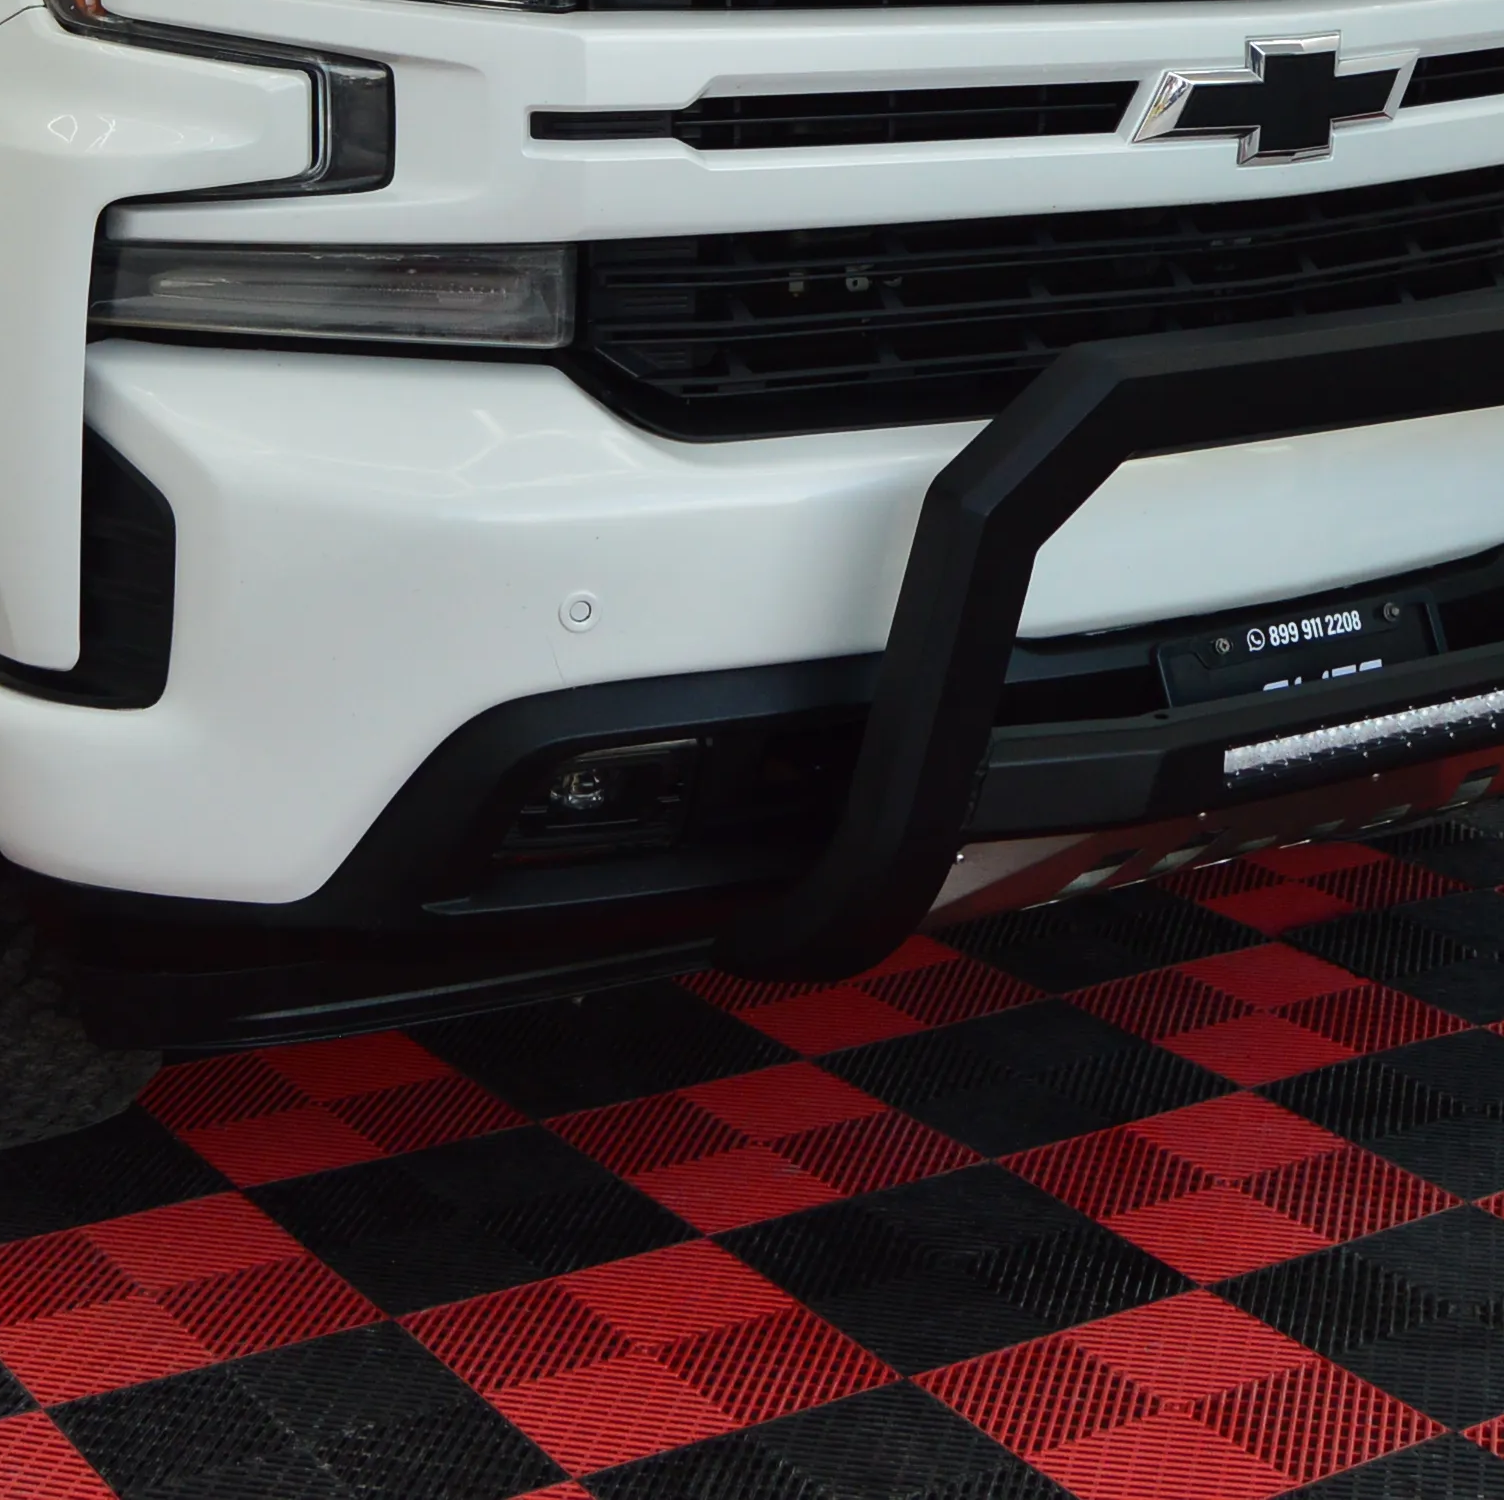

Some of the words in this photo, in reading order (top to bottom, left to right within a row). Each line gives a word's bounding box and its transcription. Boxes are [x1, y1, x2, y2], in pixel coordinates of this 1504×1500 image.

[1268, 621, 1300, 647] 899
[1301, 616, 1324, 641] 911
[1324, 610, 1362, 637] 2208
